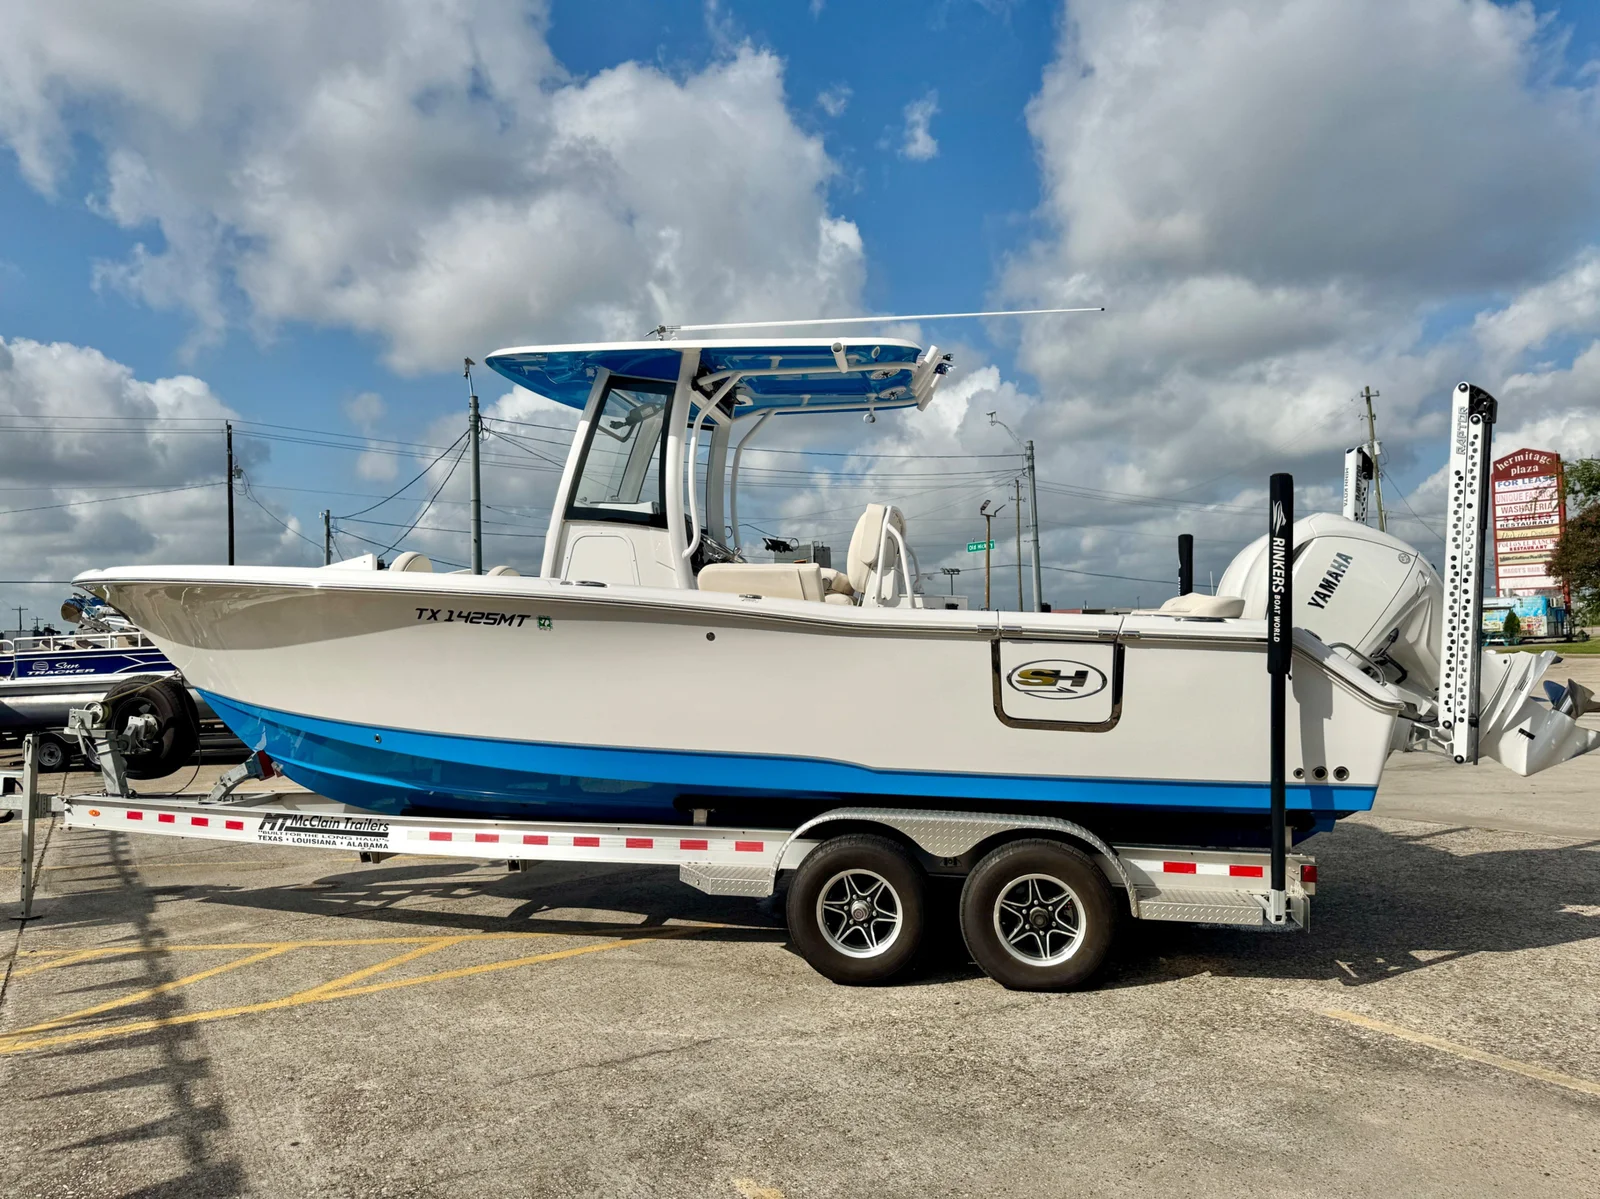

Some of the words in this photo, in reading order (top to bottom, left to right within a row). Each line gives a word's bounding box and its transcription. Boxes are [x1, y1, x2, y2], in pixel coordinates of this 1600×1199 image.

[1456, 406, 1468, 455] RAPTOR
[1496, 451, 1552, 471] hermitage
[1510, 465, 1539, 477] plaza
[1497, 480, 1519, 488] FOR
[1500, 502, 1553, 514] WASHATERIA
[1500, 519, 1555, 528] RESTAURANT
[1272, 537, 1286, 593] RINKERS
[1307, 552, 1353, 609] YAMAHA
[1273, 594, 1281, 614] BOAT
[415, 608, 441, 621] TX
[444, 609, 531, 627] 1425MT
[1273, 615, 1281, 643] WORLD
[27, 668, 95, 676] TRACKER
[290, 814, 340, 829] McClain
[344, 817, 390, 832] Trailers
[258, 834, 283, 842] TEXAS
[292, 837, 337, 846] LOUISIANA
[346, 841, 389, 849] ALABAMA
